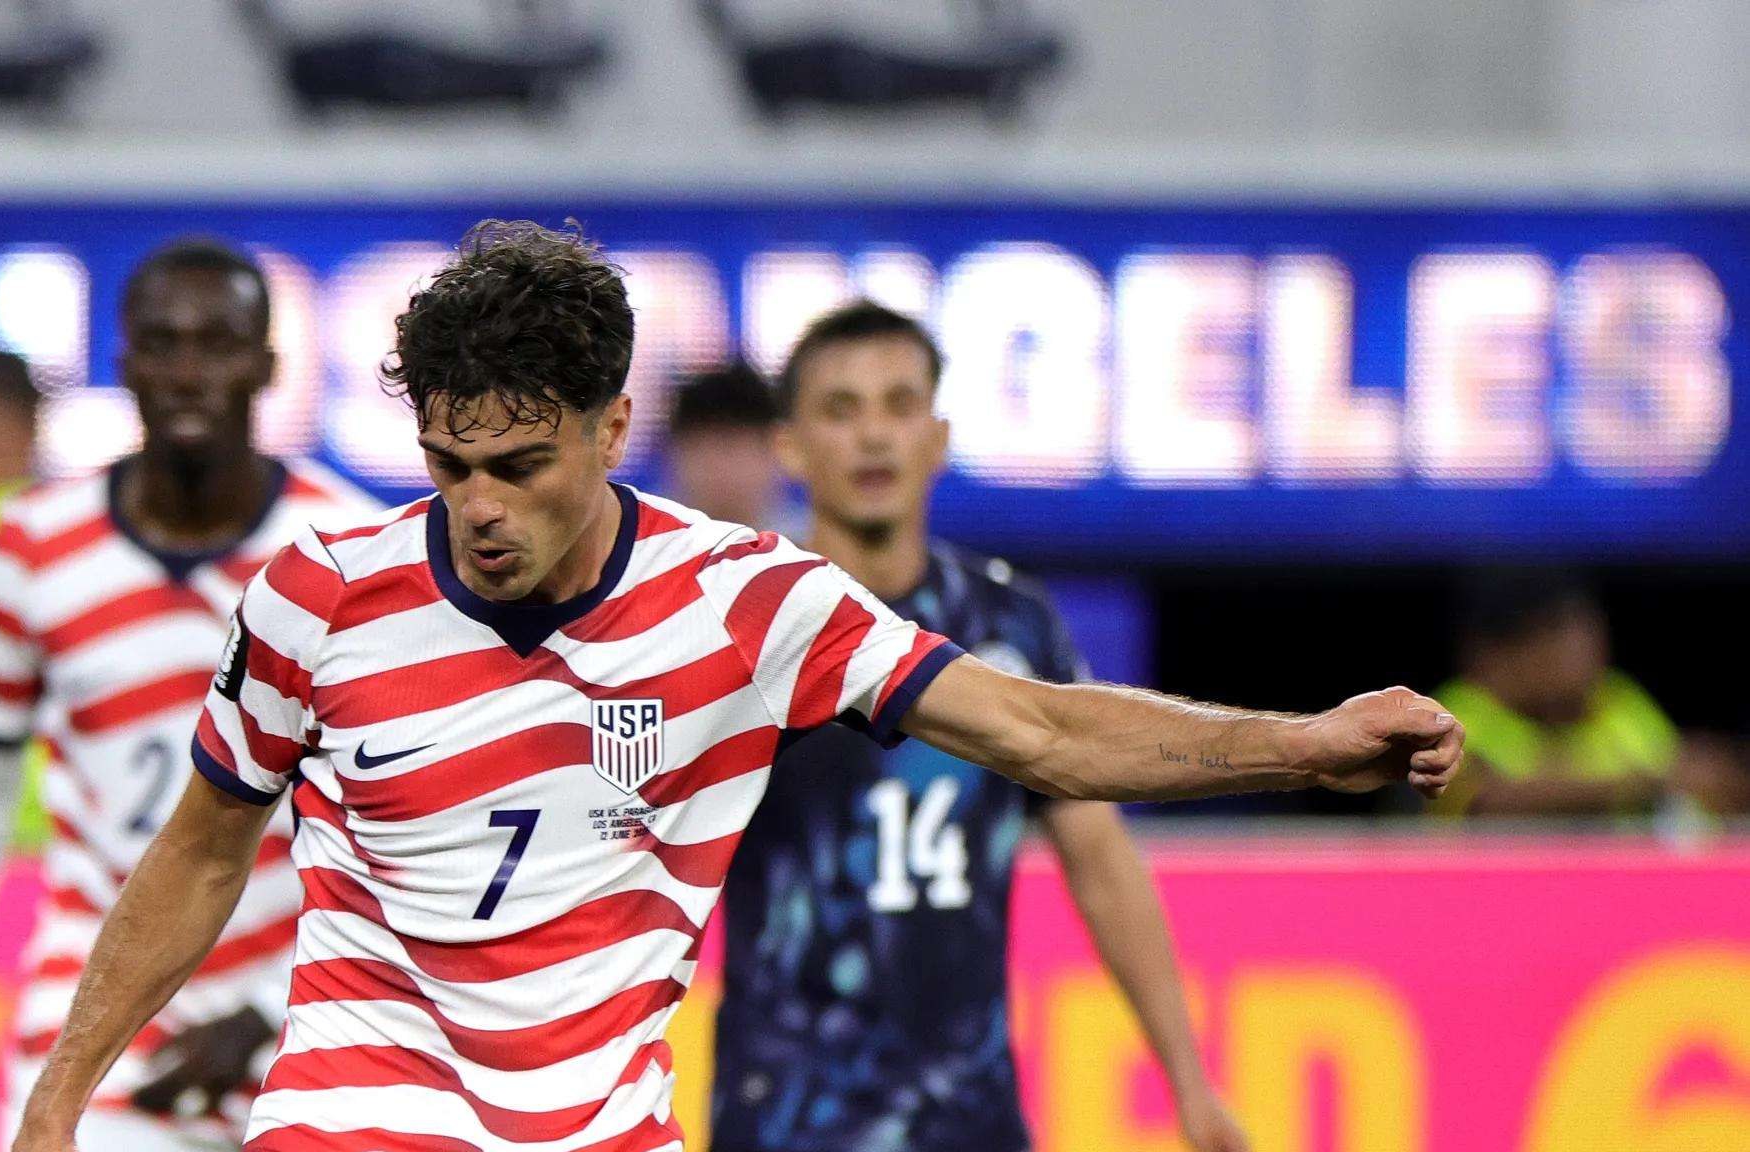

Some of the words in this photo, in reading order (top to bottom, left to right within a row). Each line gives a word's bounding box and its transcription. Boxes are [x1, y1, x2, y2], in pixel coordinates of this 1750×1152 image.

[597, 704, 657, 740] USA
[472, 808, 542, 921] 7
[867, 775, 973, 912] 14
